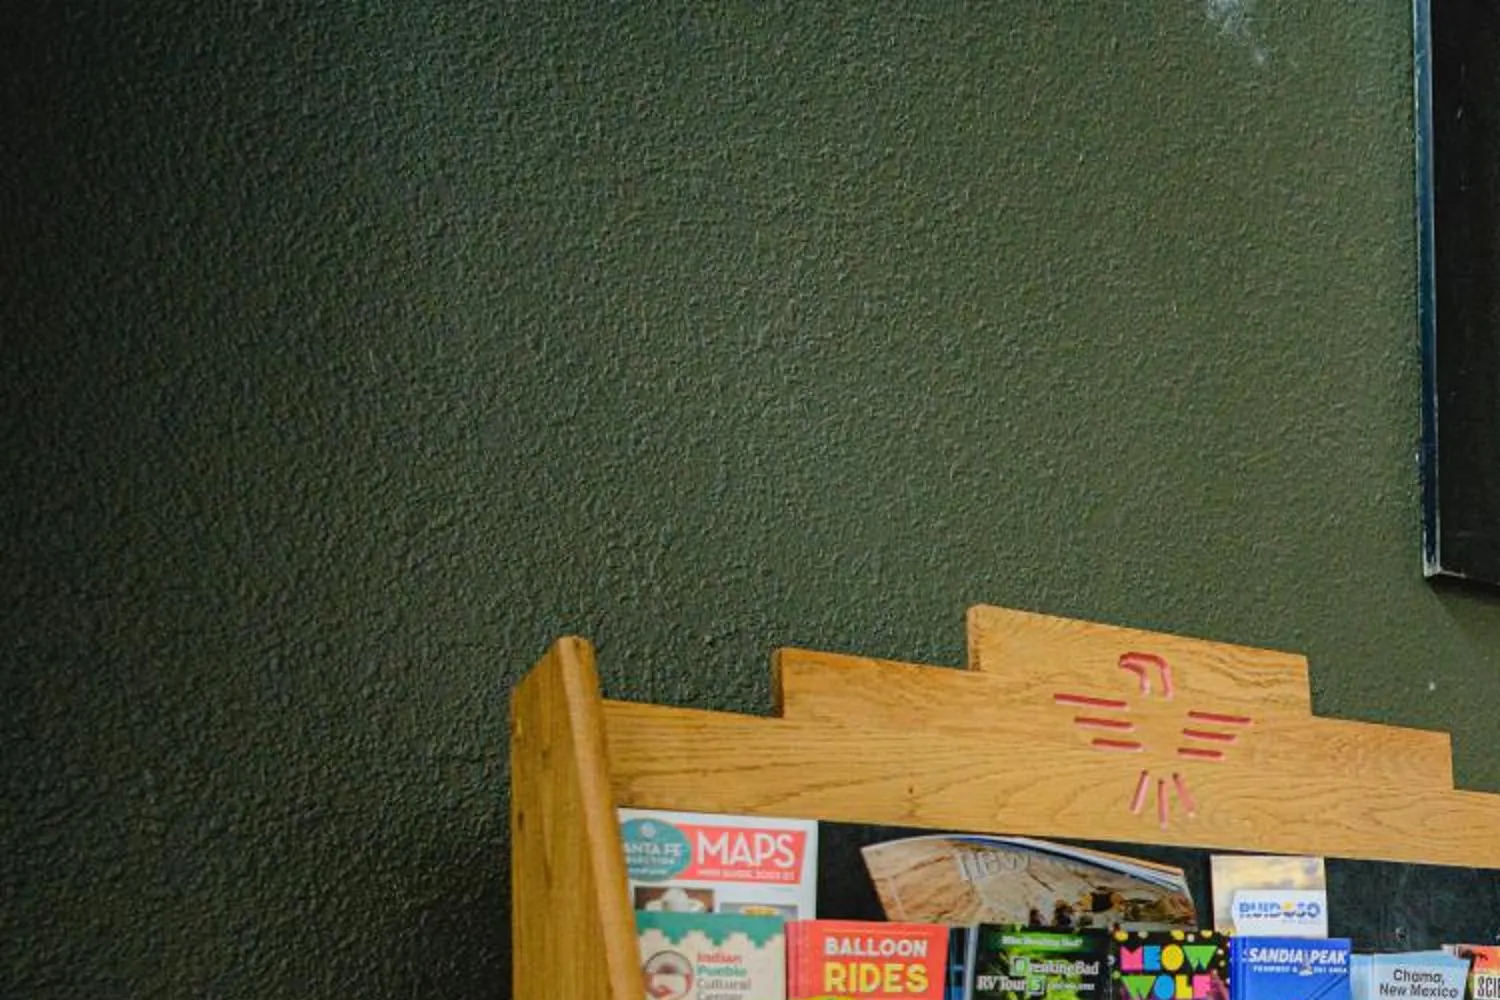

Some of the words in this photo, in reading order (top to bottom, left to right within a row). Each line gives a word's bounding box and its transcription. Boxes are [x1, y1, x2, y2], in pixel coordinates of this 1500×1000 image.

[622, 842, 662, 857] ANTA
[697, 831, 796, 869] MAPS
[824, 937, 928, 957] BALLOON
[1249, 947, 1303, 964] SANDIA
[1309, 949, 1348, 965] PEAK
[696, 951, 743, 965] Indian
[1119, 945, 1219, 972] MEOW
[696, 965, 748, 979] Pueblo
[824, 963, 929, 993] RIDES
[1393, 968, 1446, 987] Chama,
[696, 978, 751, 991] Cultural
[976, 975, 997, 991] RV
[1119, 975, 1213, 1000] WOLF
[1379, 984, 1408, 998] New
[1410, 984, 1460, 999] Mexico
